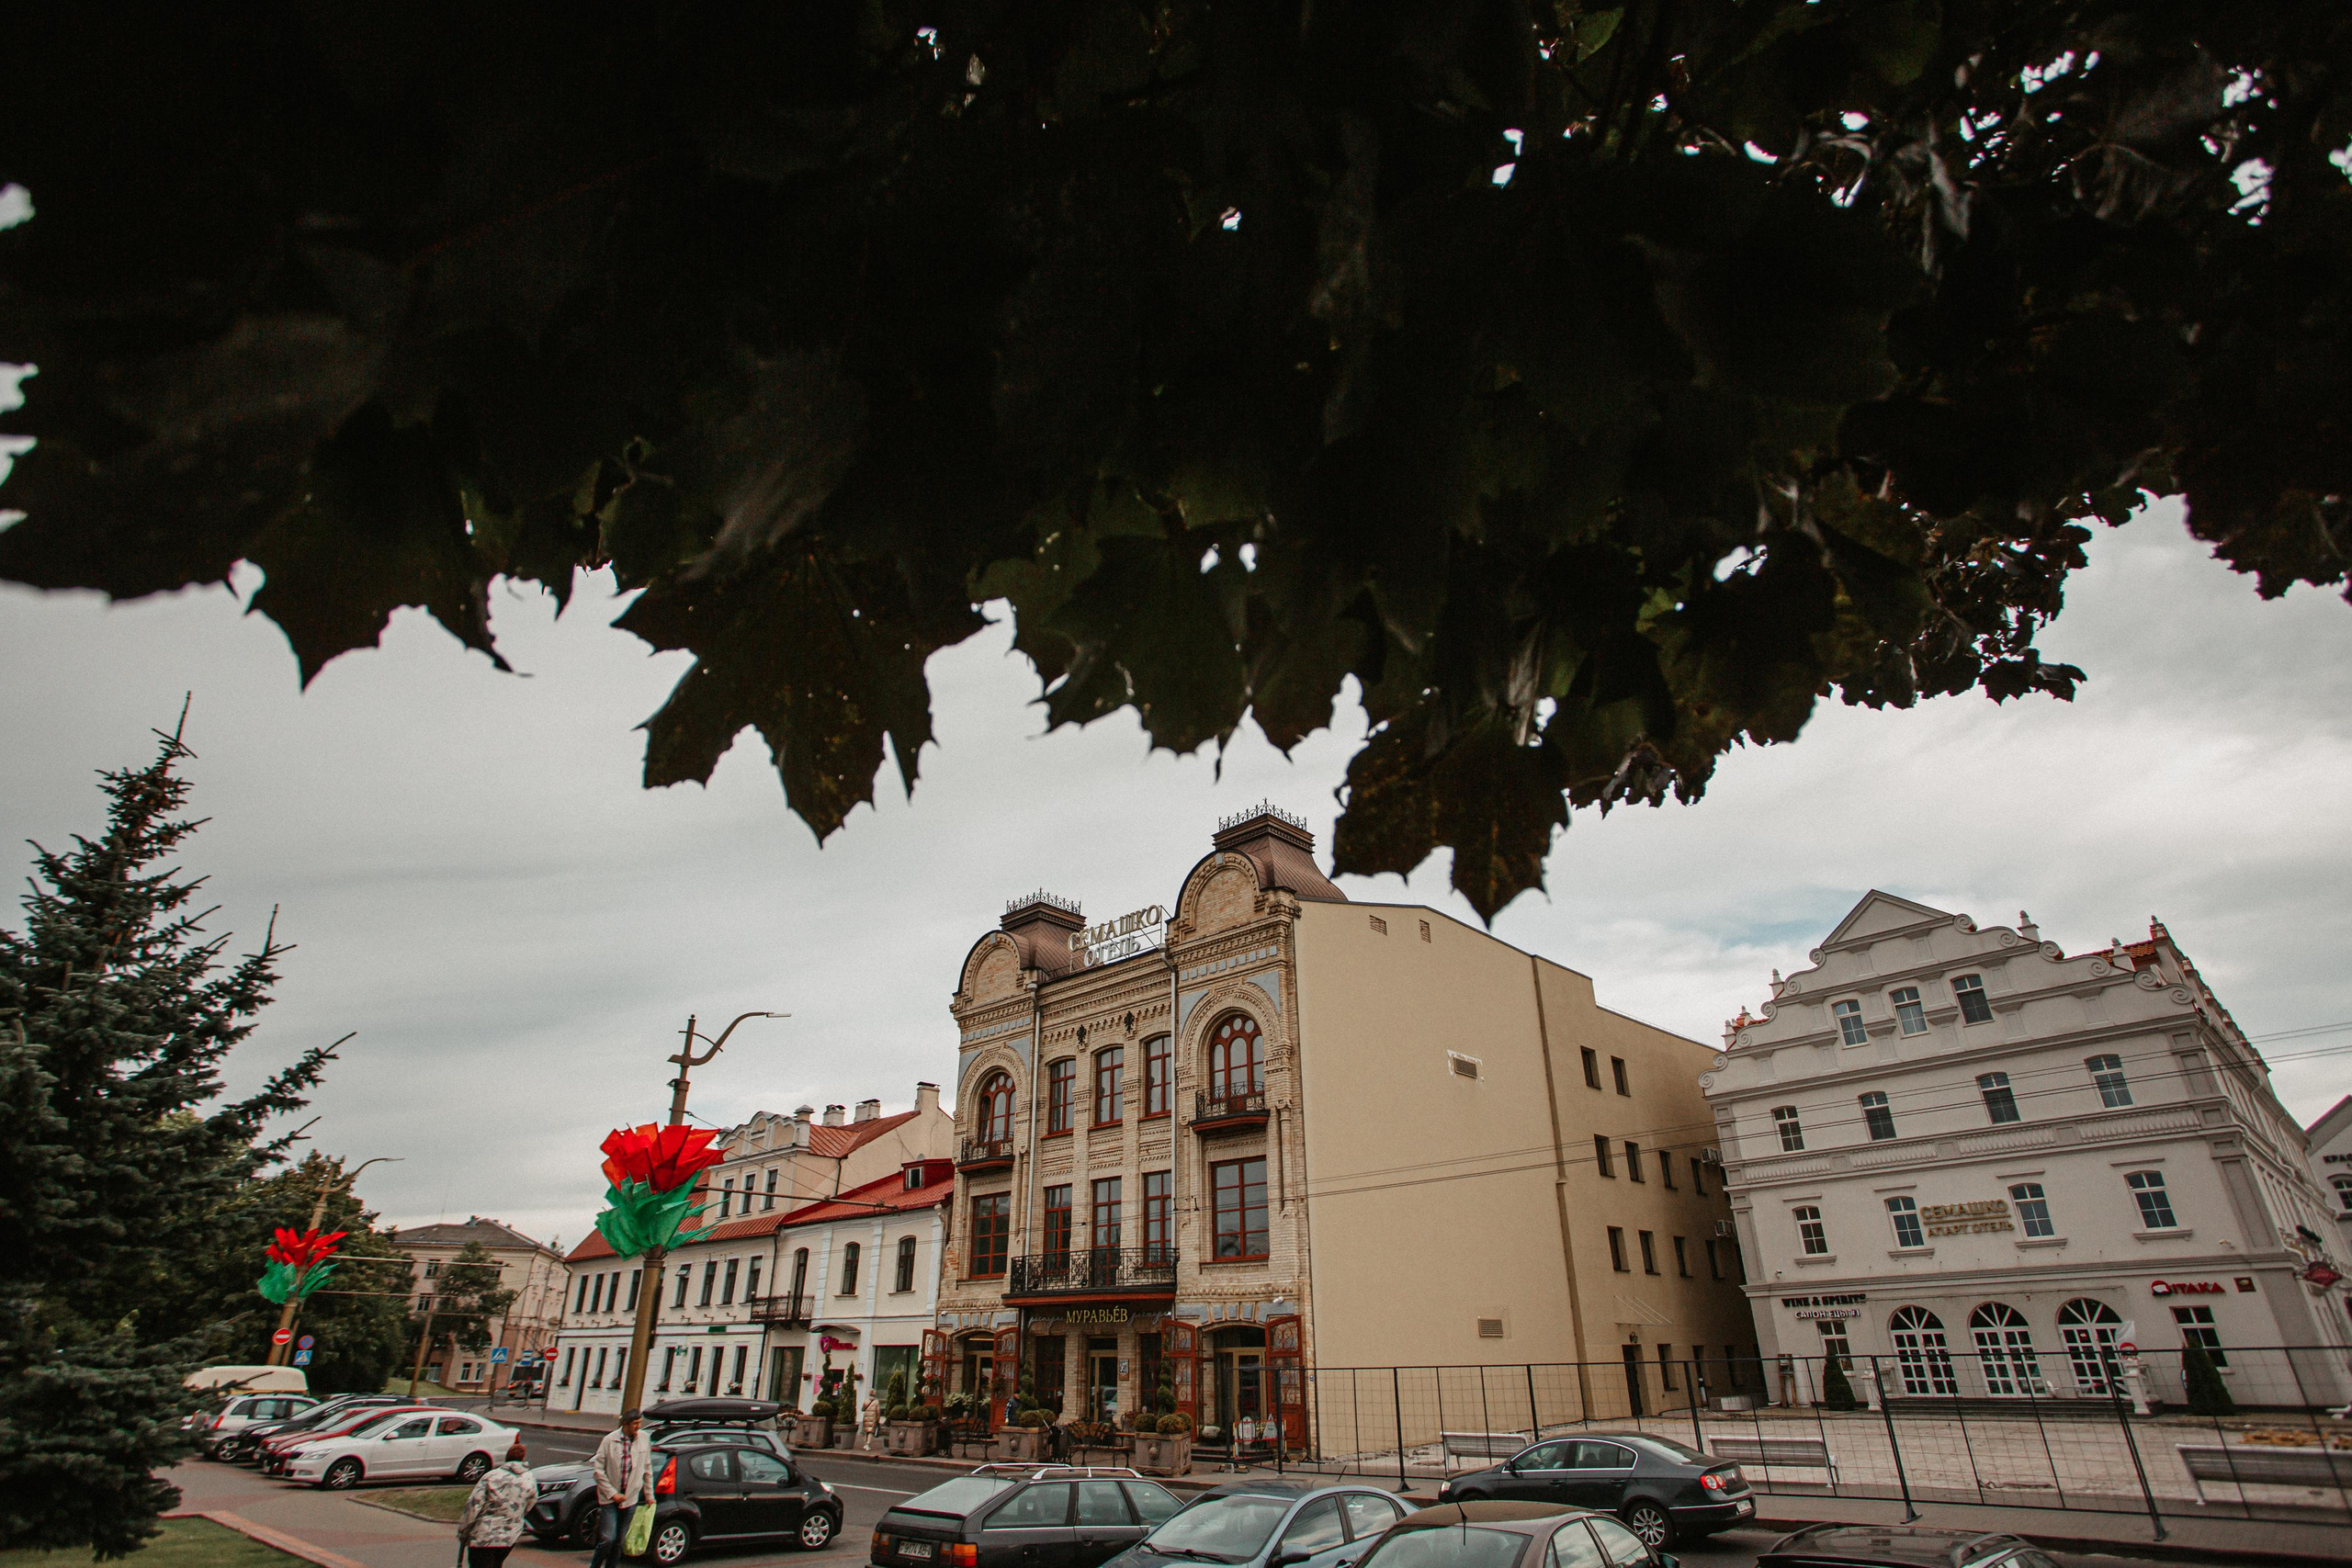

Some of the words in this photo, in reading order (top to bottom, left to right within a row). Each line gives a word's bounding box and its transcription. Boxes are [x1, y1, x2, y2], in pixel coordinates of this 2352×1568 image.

[1068, 905, 1160, 952] СЕМАШКО
[1084, 935, 1141, 967] ОТЕЛЬ
[1920, 1199, 2008, 1220] СЕМАШКО
[1928, 1224, 1968, 1237] АПАРТ
[1972, 1221, 2014, 1234] ОТЕЛЬ
[1781, 1297, 1811, 1307] WINE
[1812, 1296, 1821, 1305] &
